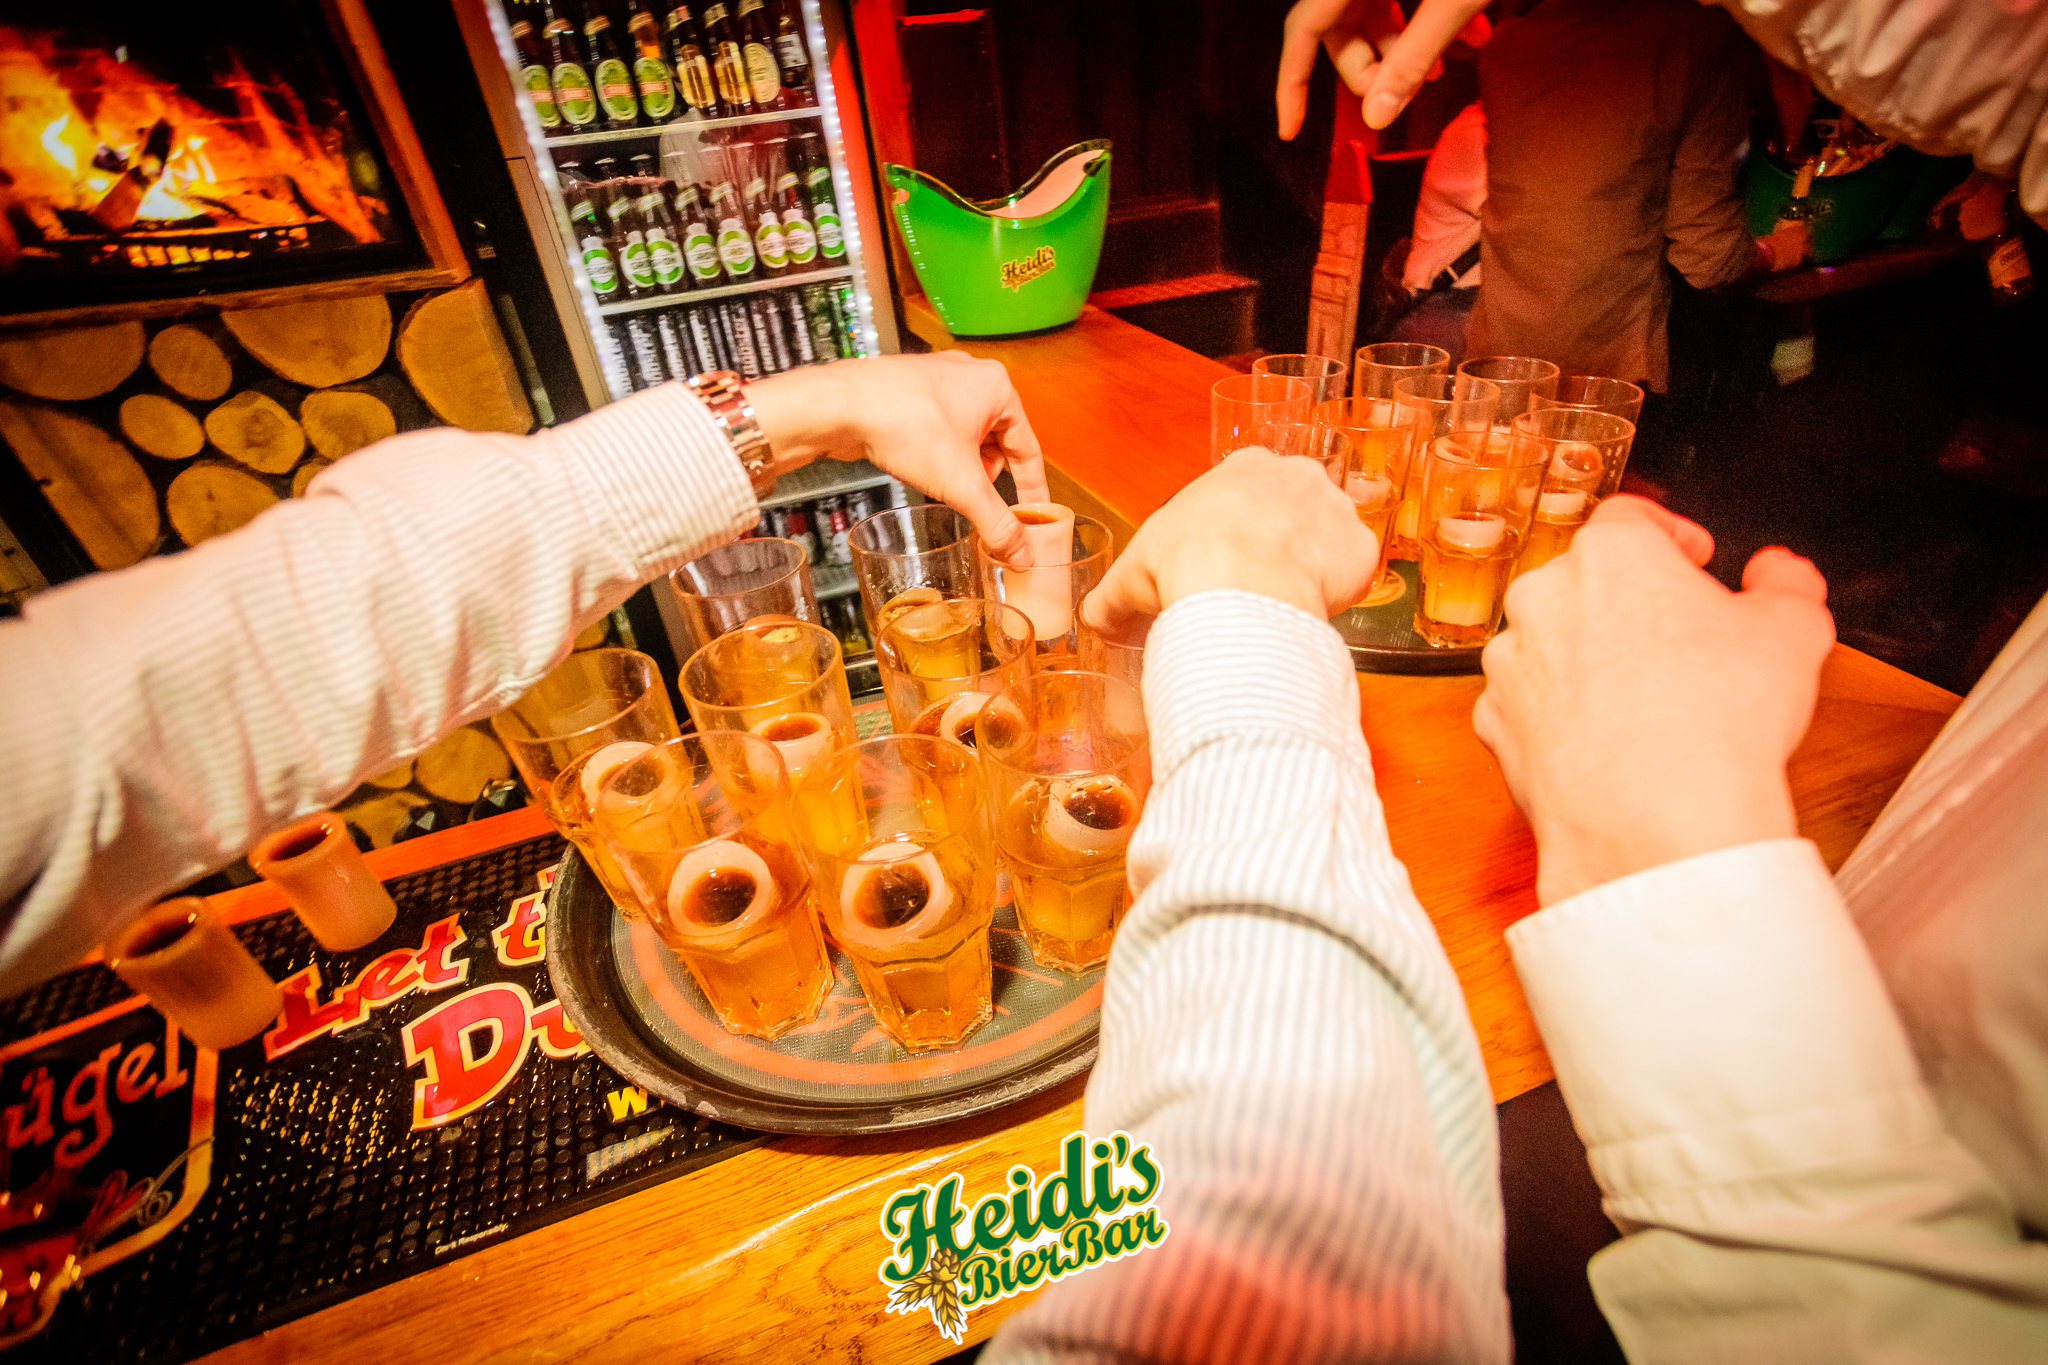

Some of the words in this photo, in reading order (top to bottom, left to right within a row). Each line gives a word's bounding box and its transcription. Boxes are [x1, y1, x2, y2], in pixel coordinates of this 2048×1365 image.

[1001, 246, 1054, 282] Heidi's
[265, 915, 468, 1060] Let
[0, 1018, 189, 1168] ügel
